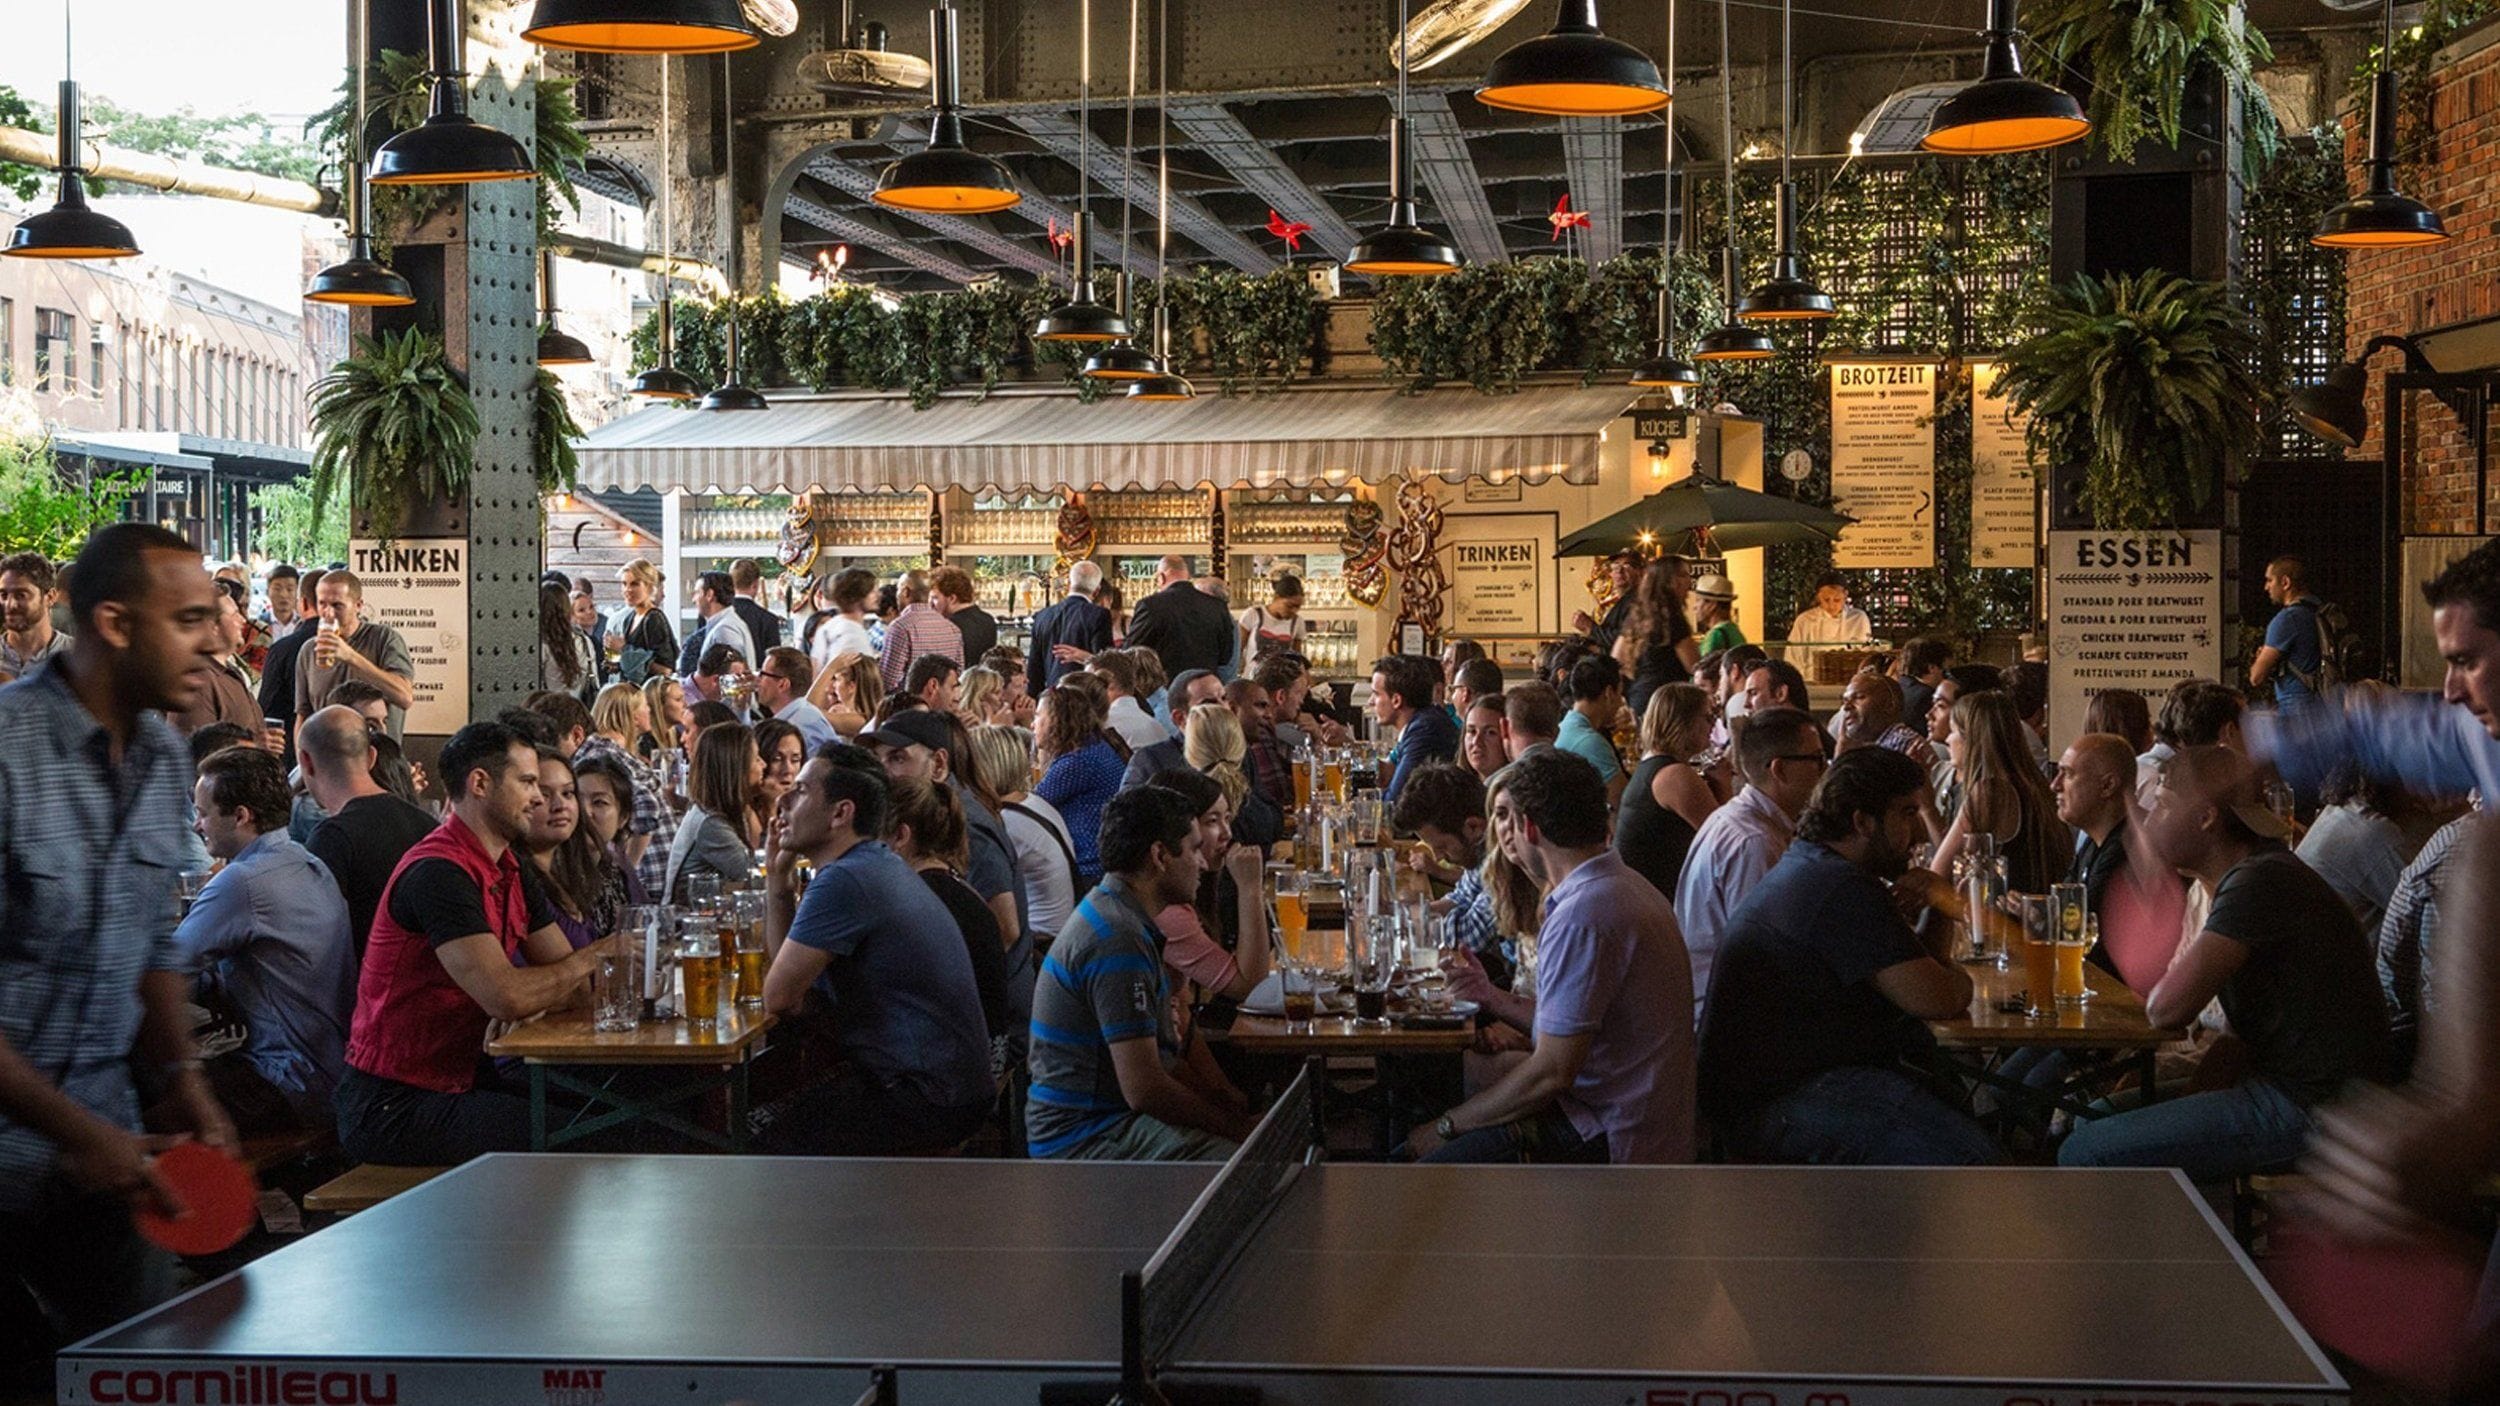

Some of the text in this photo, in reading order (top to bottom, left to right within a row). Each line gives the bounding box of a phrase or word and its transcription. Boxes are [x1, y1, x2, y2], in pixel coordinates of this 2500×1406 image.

[1840, 366, 1925, 386] BROTZEIT
[1457, 545, 1532, 562] TRINKEN
[2077, 538, 2192, 568] ESSEN
[355, 548, 460, 574] TRINKEN
[1688, 563, 1720, 575] UTEN
[2063, 597, 2205, 606] STANDARD PORK BRATWURST
[2060, 615, 2207, 625] CHEDDAR & PORK KURTWURST
[2081, 633, 2186, 643] CHICKEN BRATWURST
[2078, 651, 2189, 661] SCHARFE CURRYWURST
[2073, 668, 2196, 678] PRETZELWURST AMANDA
[89, 1365, 397, 1405] cornilleau
[543, 1369, 607, 1389] MAT
